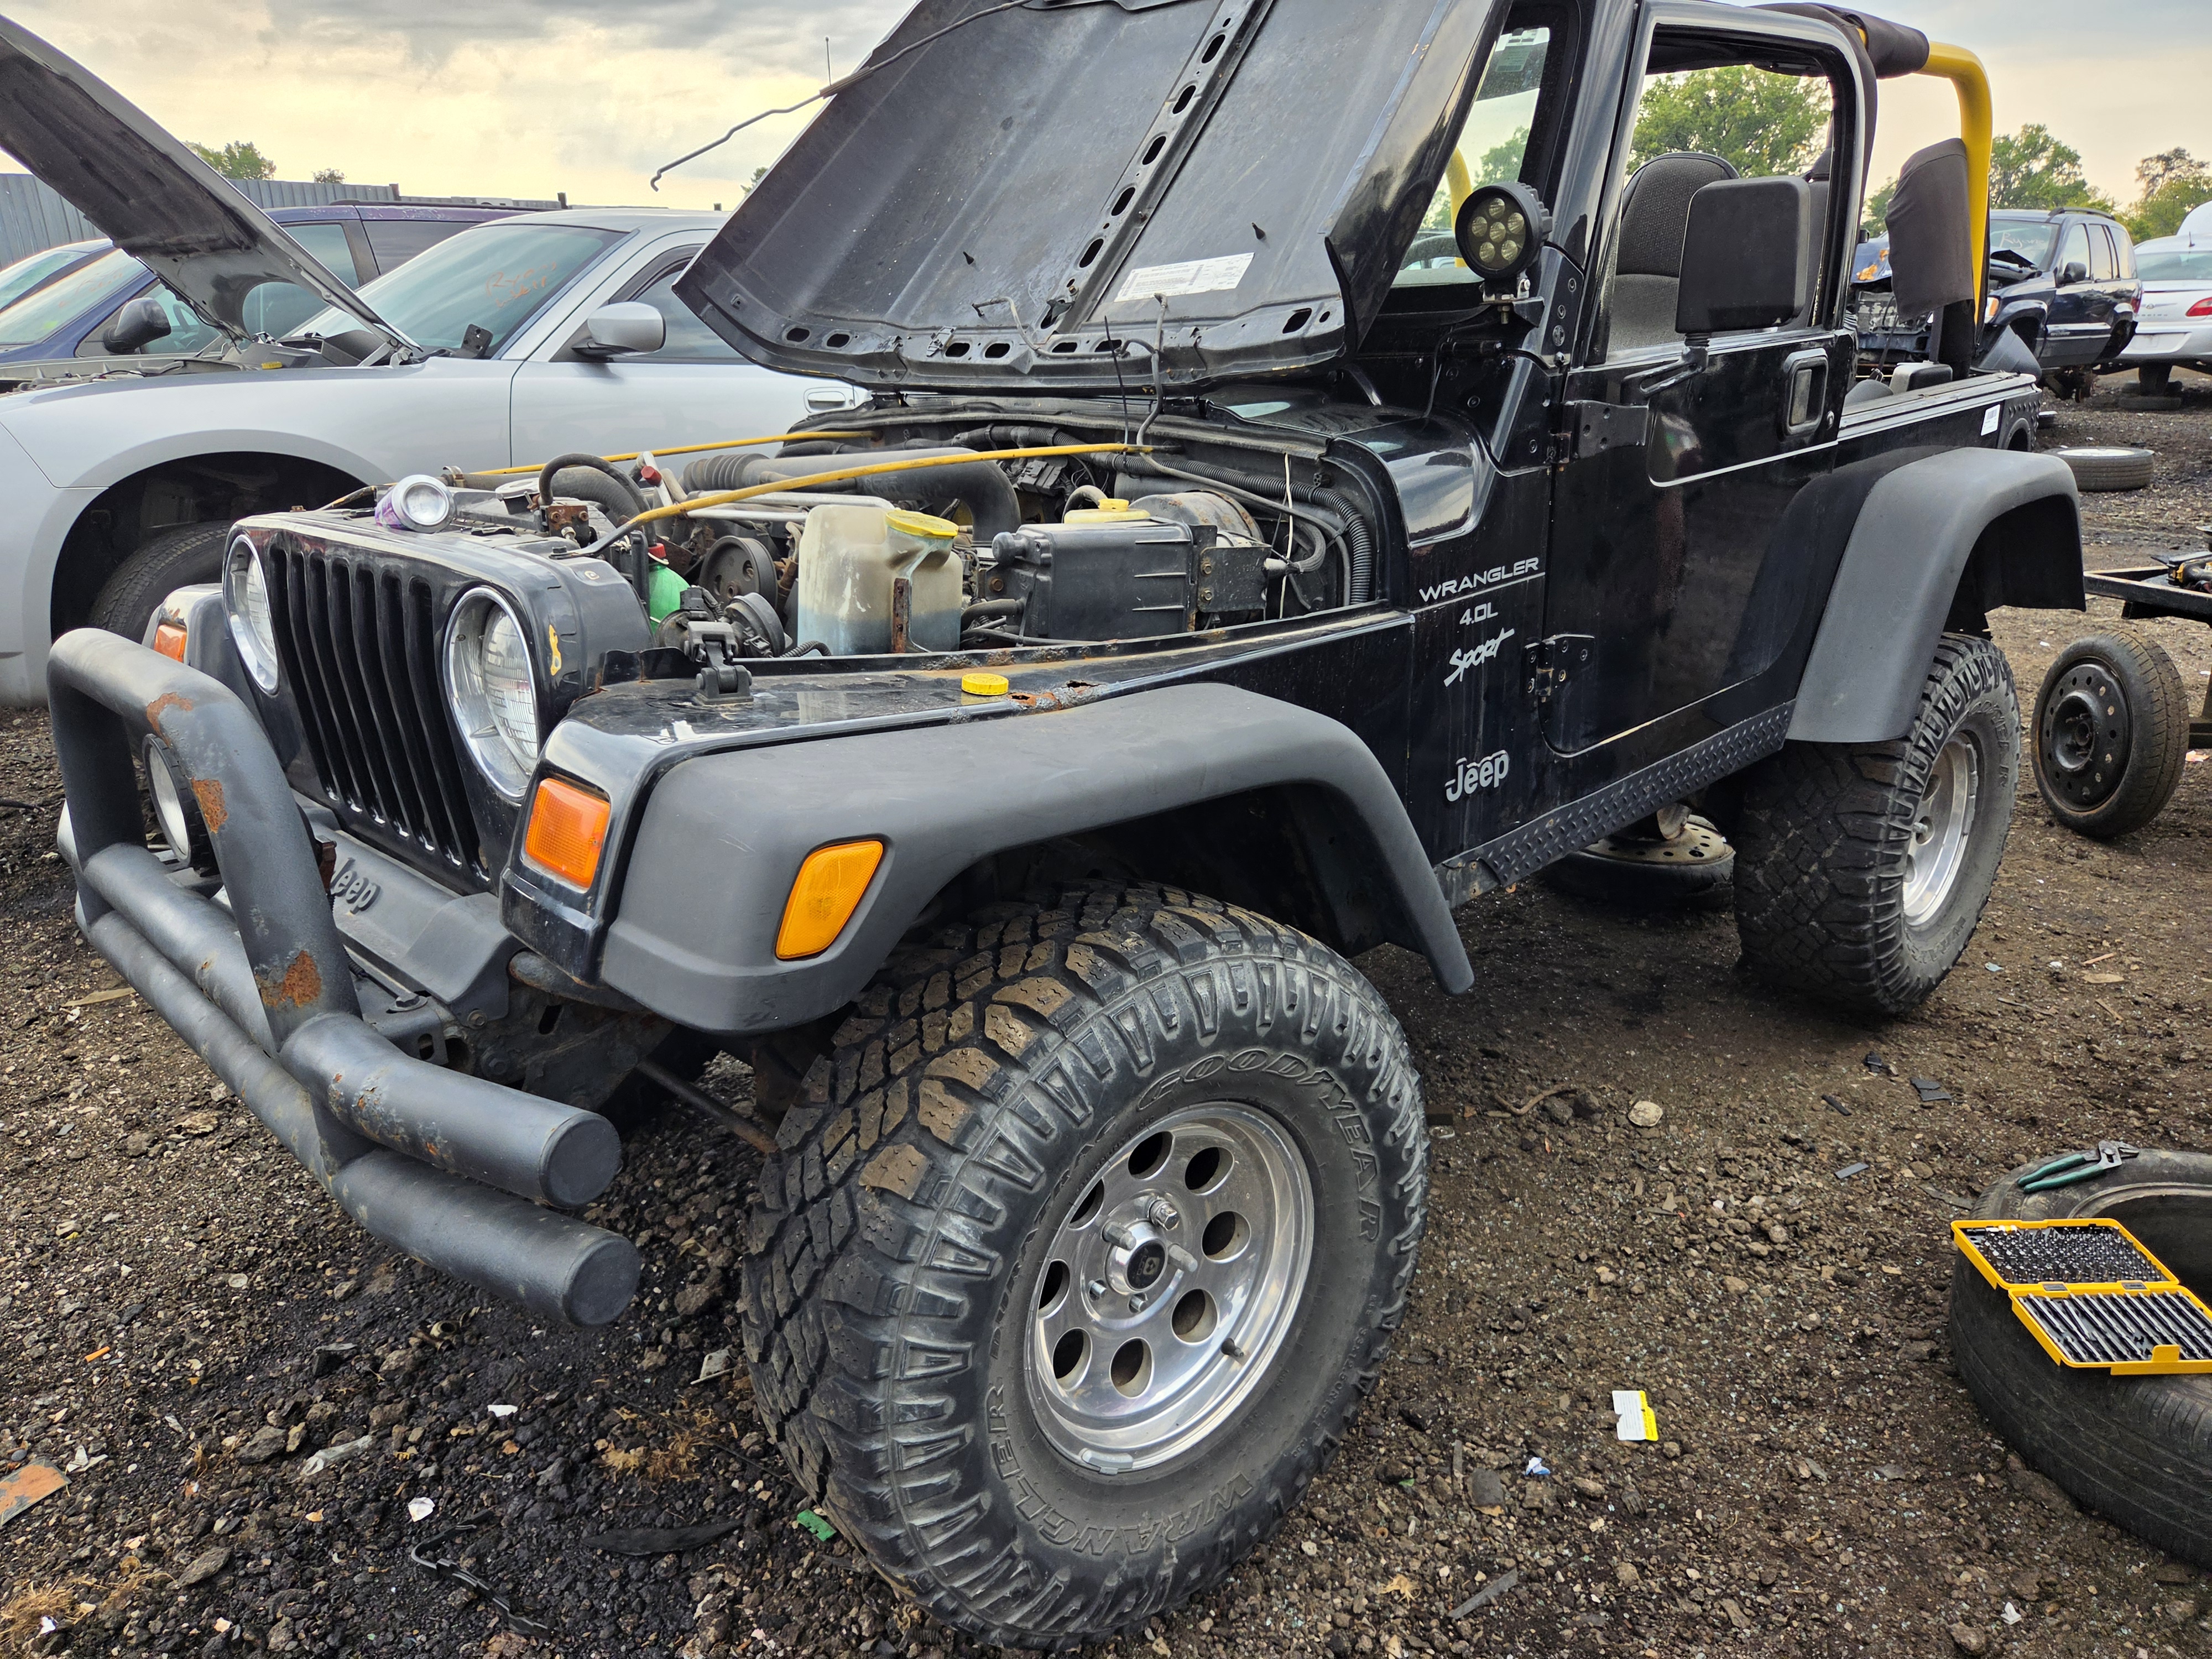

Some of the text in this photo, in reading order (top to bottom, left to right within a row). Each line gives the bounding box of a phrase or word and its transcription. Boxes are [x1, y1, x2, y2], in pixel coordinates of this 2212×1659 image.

[1419, 557, 1539, 602] WRANGLER
[1459, 602, 1499, 625] 4.0L
[1443, 627, 1515, 687] Sport
[1444, 750, 1509, 802] Jeep
[330, 857, 381, 915] Jeep
[1137, 1047, 1381, 1241] GOODYEAR
[985, 1384, 1254, 1556] WRANGLER
